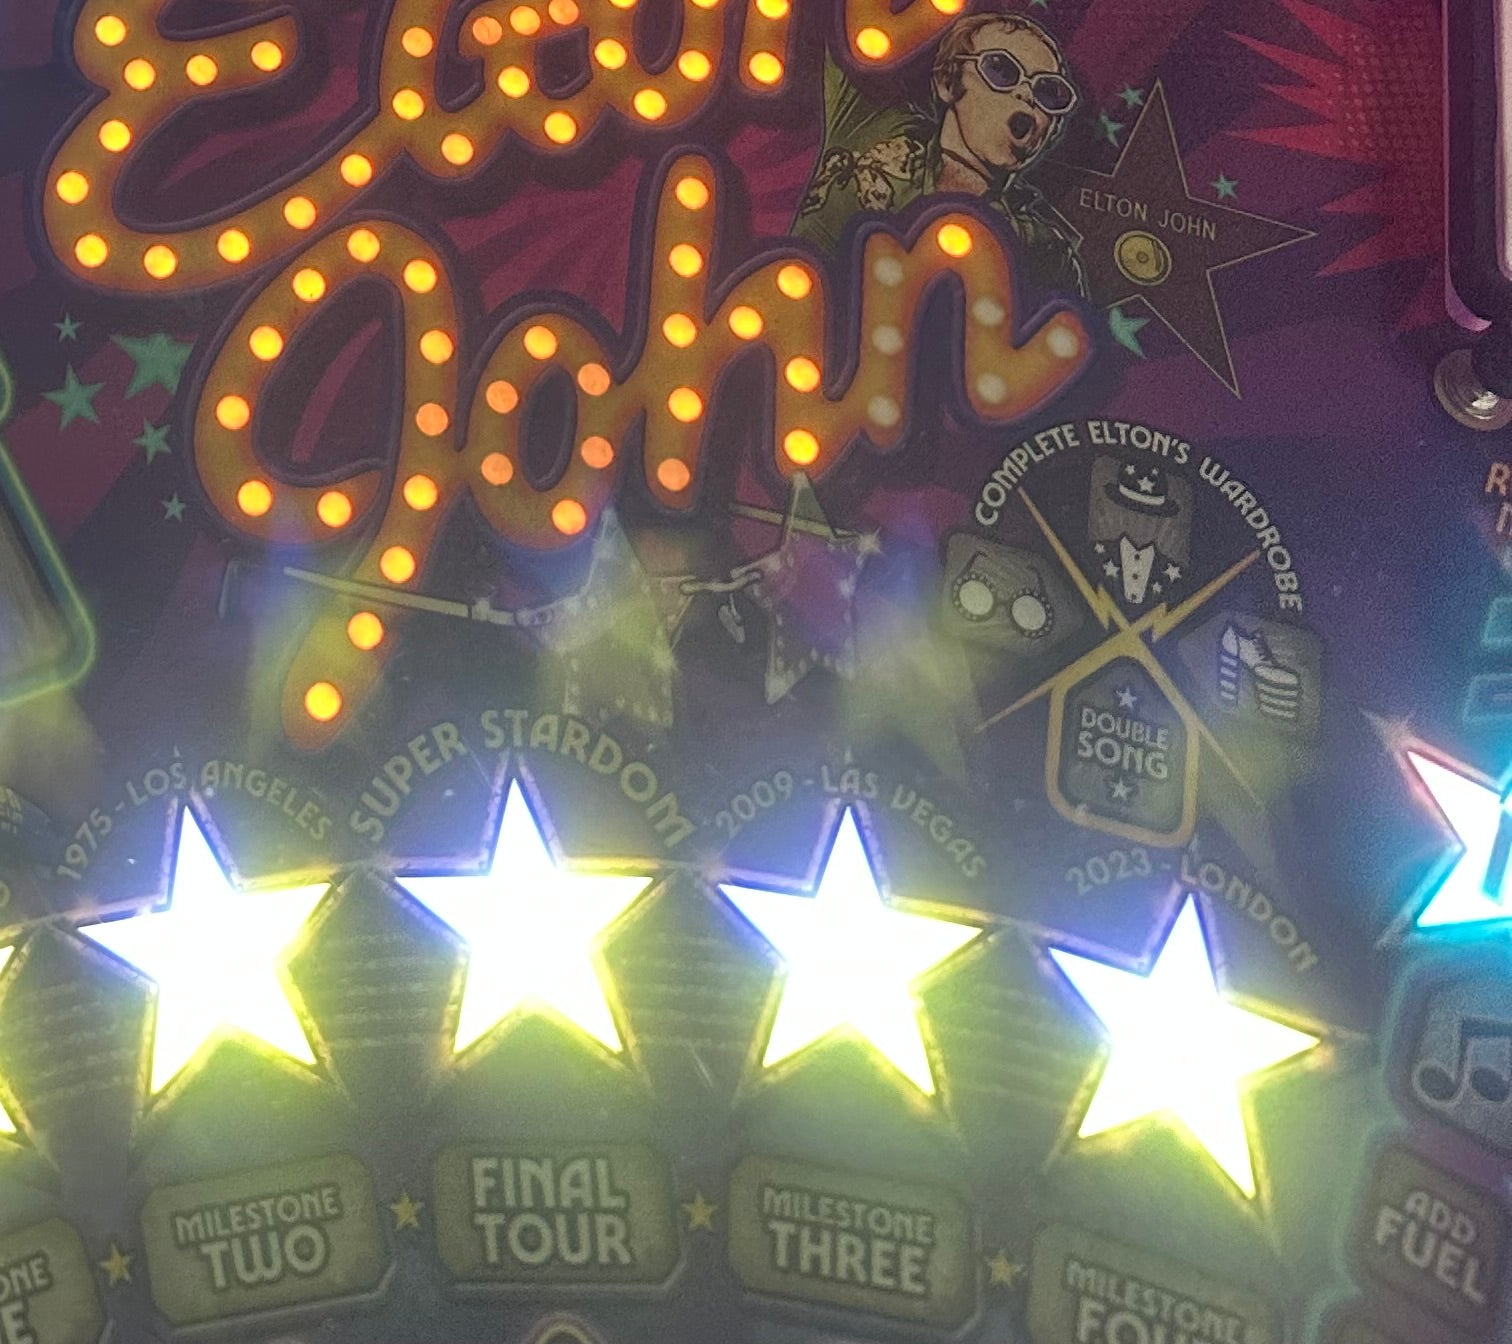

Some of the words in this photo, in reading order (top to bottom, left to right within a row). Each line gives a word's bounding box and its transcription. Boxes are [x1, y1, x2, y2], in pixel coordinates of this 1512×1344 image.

[1078, 185, 1149, 223] ELTON
[1155, 208, 1218, 242] JOHN
[196, 148, 1088, 752] John
[974, 423, 1081, 527] COMPLETE
[1086, 419, 1192, 465] ELTON'S
[1197, 455, 1304, 613] WARDROBE
[1076, 731, 1169, 780] SONG
[1080, 708, 1169, 751] DOUBLE
[349, 721, 469, 844] SUPER
[480, 708, 699, 850] STARDOM
[56, 807, 114, 881] 1975
[125, 761, 188, 807] LOS
[200, 759, 333, 842] ANGELES
[715, 769, 795, 839] 2009
[820, 764, 881, 800] LAS
[890, 783, 987, 879] VEGAS
[1064, 846, 1153, 897] 2023
[1180, 853, 1320, 974] LONDON
[173, 1186, 343, 1246] MILESTONE
[471, 1156, 629, 1210] FINAL
[761, 1185, 937, 1247] MILESTONE
[1404, 1190, 1478, 1246] ADD
[197, 1224, 328, 1291] TWO
[472, 1210, 634, 1266] TOUR
[769, 1217, 929, 1295] THREE
[1374, 1204, 1488, 1305] FUEL
[1066, 1258, 1242, 1344] MILESTONE
